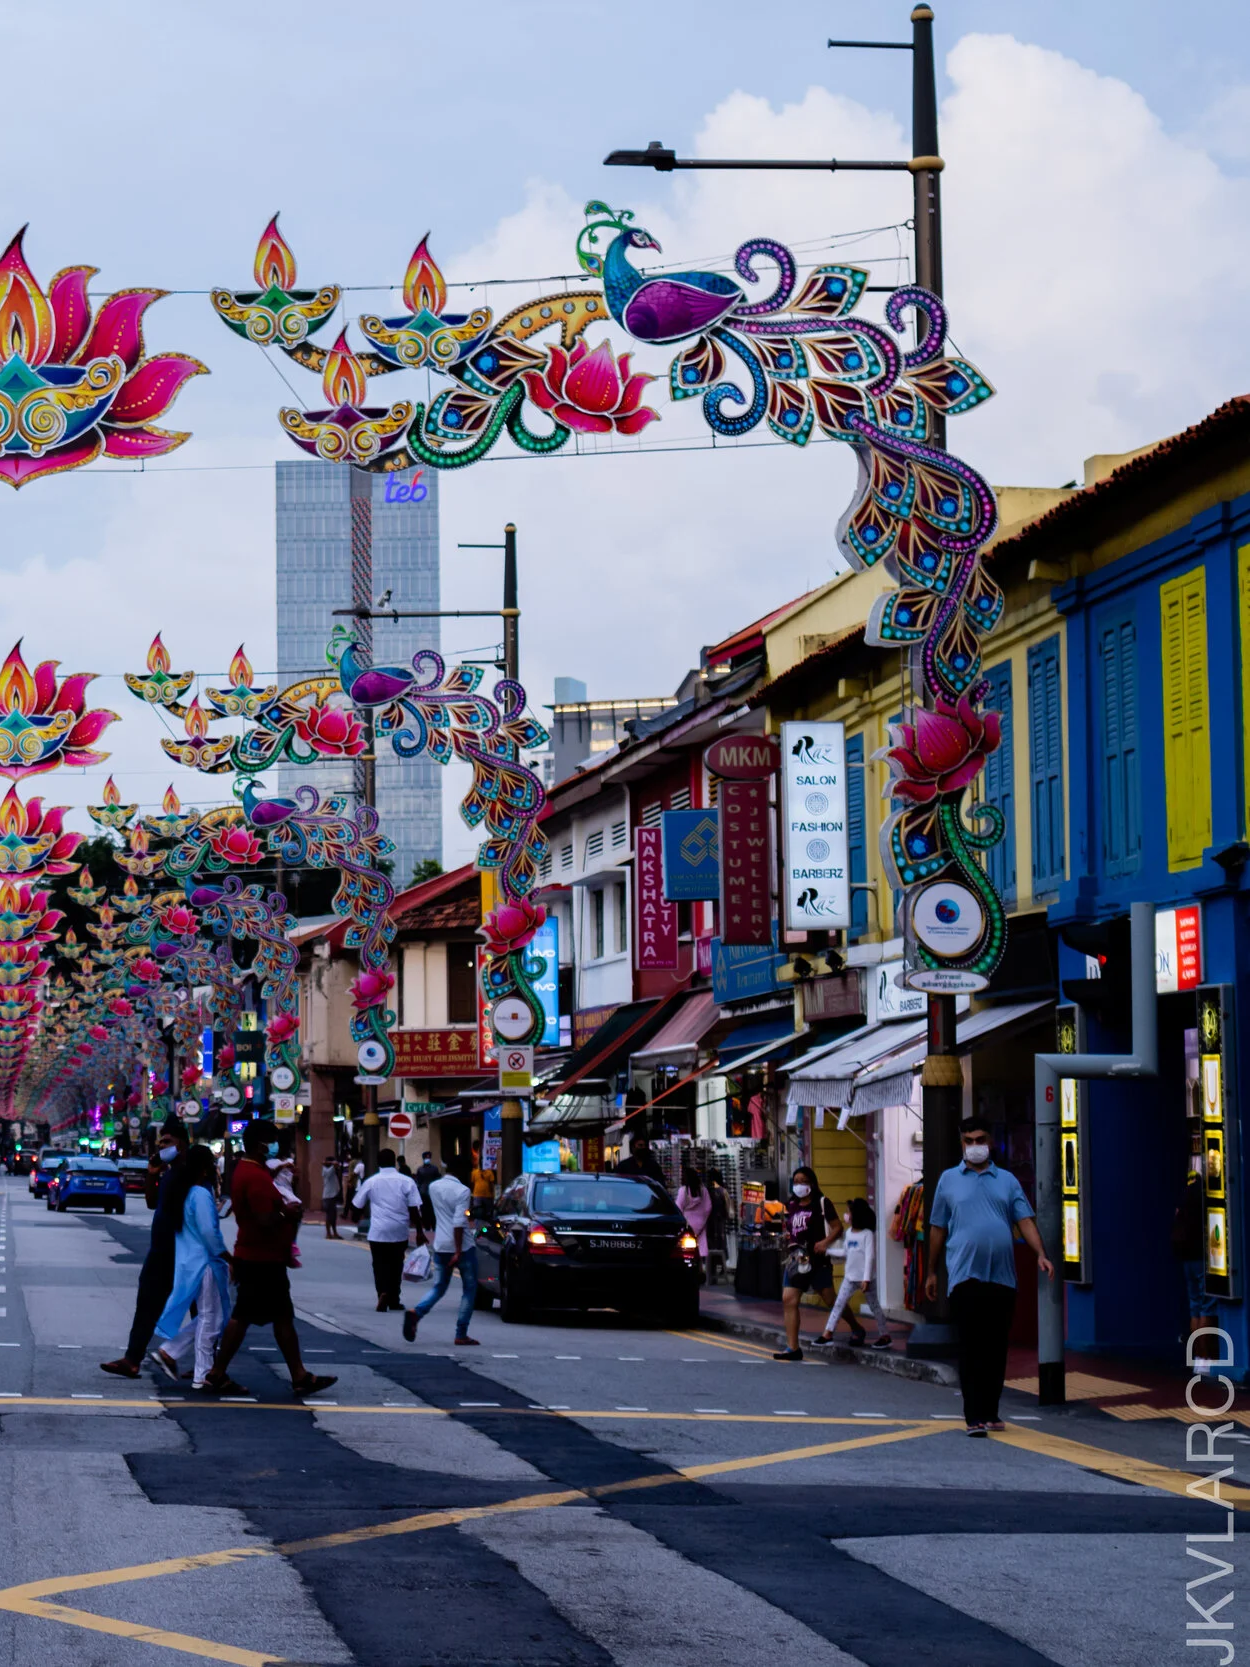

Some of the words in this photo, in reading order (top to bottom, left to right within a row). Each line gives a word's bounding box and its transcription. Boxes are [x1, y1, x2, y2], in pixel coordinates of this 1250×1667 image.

[719, 747, 771, 767] MKM
[796, 775, 837, 786] SALON
[791, 822, 843, 832] FASHION
[728, 786, 745, 904] COSTUME
[747, 806, 764, 939] JEWELLERY
[793, 869, 843, 879] BARBERZ
[642, 832, 656, 957] NAKSHATRA
[533, 982, 556, 991] ivo
